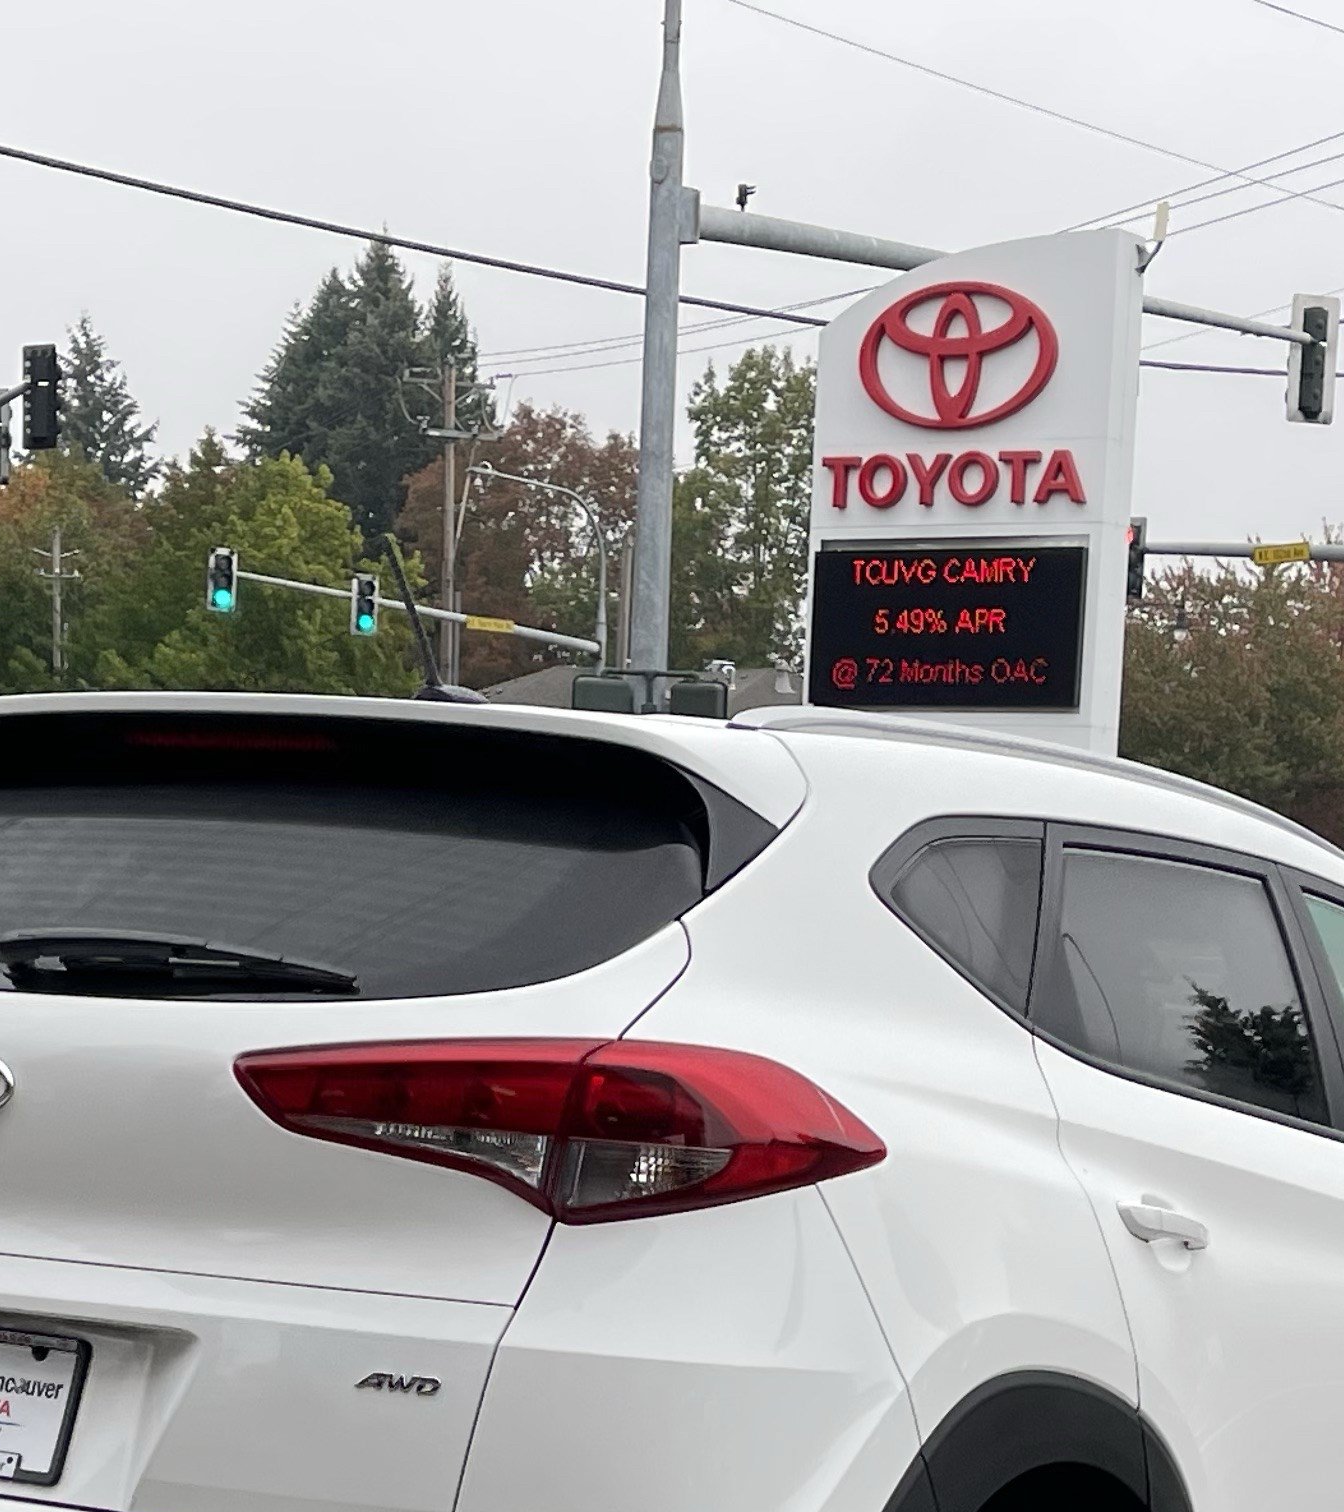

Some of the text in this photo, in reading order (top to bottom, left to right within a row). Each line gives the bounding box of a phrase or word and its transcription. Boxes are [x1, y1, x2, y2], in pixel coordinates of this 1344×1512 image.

[822, 449, 1087, 509] TOYOTA
[942, 556, 1037, 584] CAMRY
[955, 607, 1007, 634] APR
[831, 656, 1050, 690] @ 72 Months OAC
[355, 1372, 442, 1396] AWD
